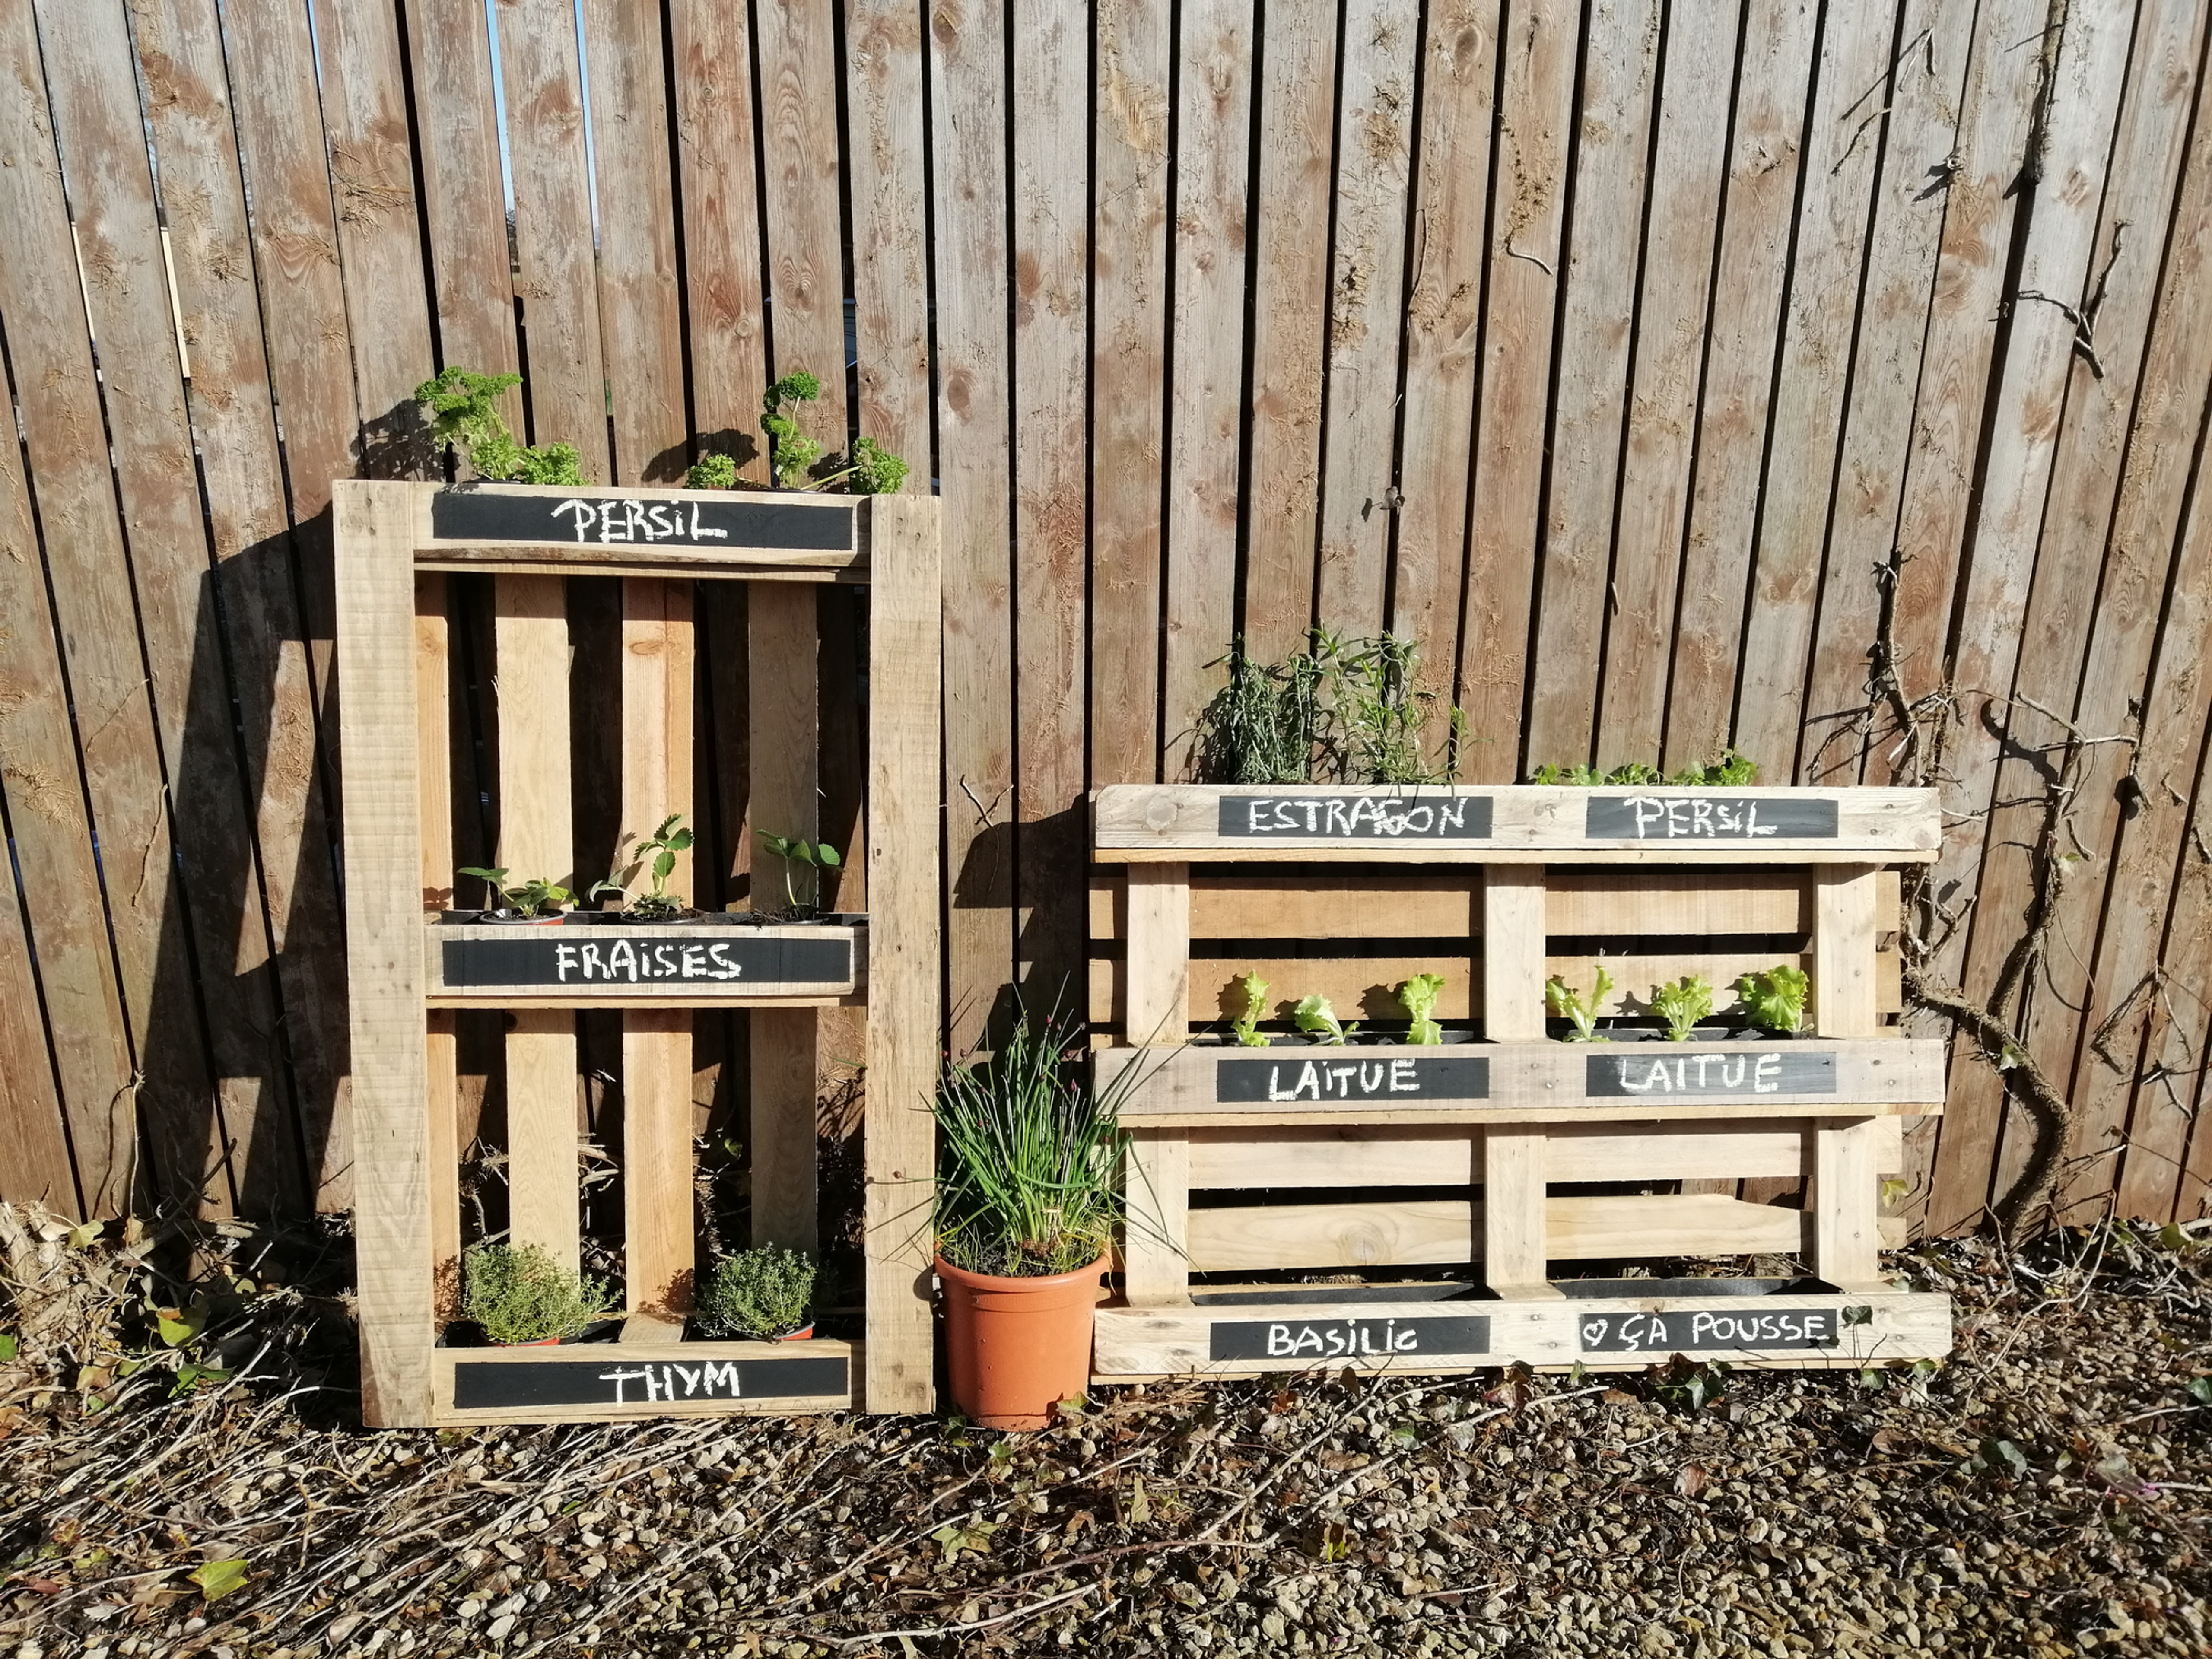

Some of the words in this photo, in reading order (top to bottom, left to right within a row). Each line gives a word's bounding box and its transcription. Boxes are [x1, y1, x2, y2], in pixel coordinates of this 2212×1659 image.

[1249, 798, 1467, 835] ESTRAGON
[1621, 1054, 1780, 1093] LAITUE
[1620, 1314, 1667, 1350] ÇA
[1692, 1312, 1830, 1344] POUSSE
[600, 1362, 740, 1407] THYM
